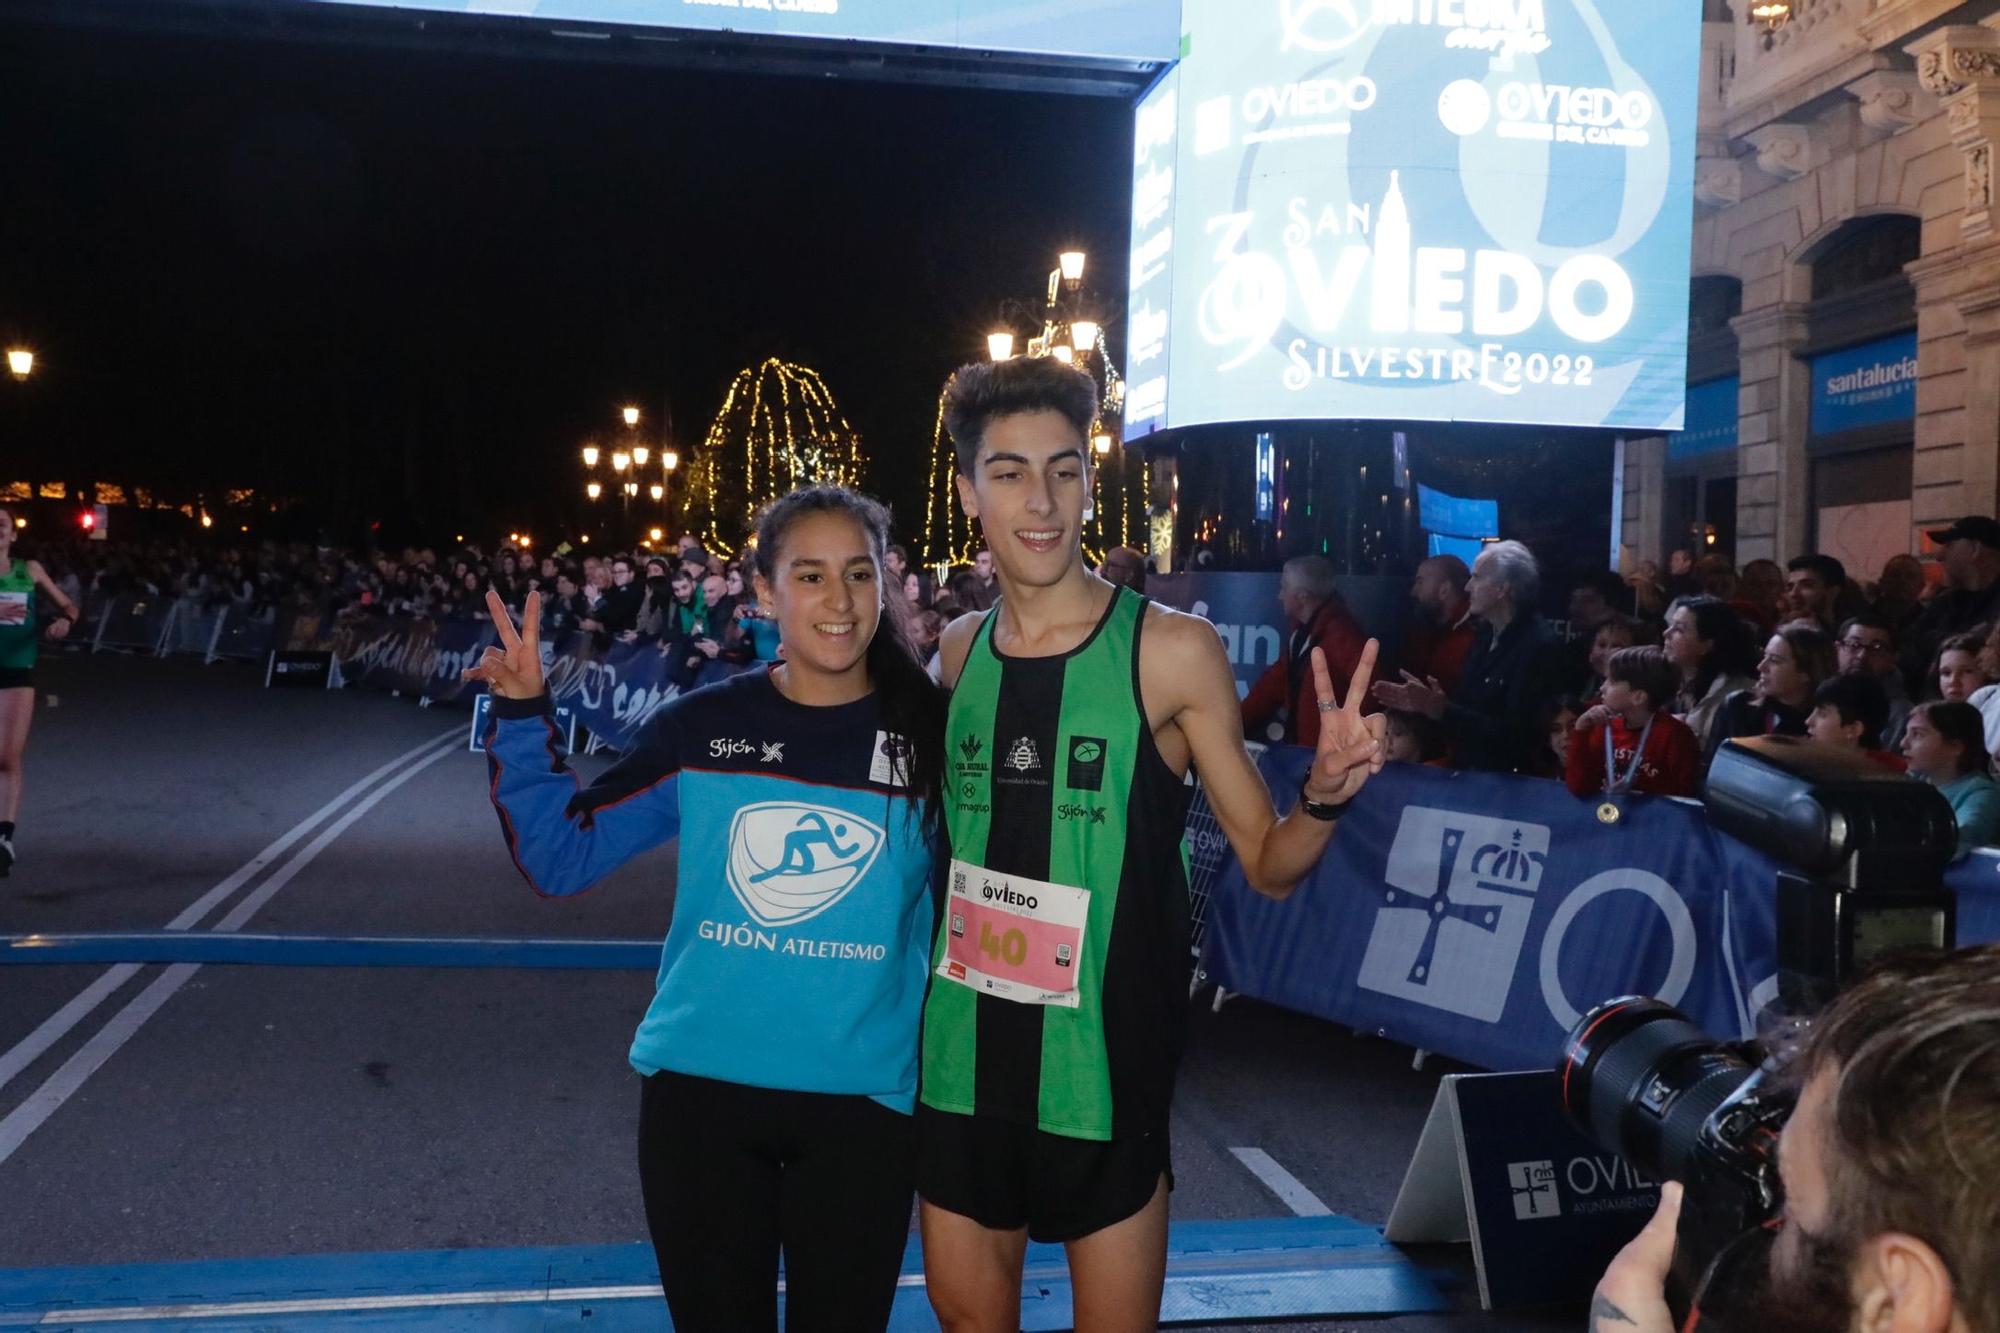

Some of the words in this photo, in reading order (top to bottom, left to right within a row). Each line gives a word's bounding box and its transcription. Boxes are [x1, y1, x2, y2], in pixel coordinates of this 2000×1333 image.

[1243, 77, 1376, 120] OVIEDO
[1282, 196, 1371, 248] SAN
[709, 738, 756, 758] gijón
[982, 880, 1038, 909] OVIEDO
[699, 920, 777, 951] GIJÓN
[782, 938, 886, 961] ATLETISMO
[978, 920, 1028, 967] 40
